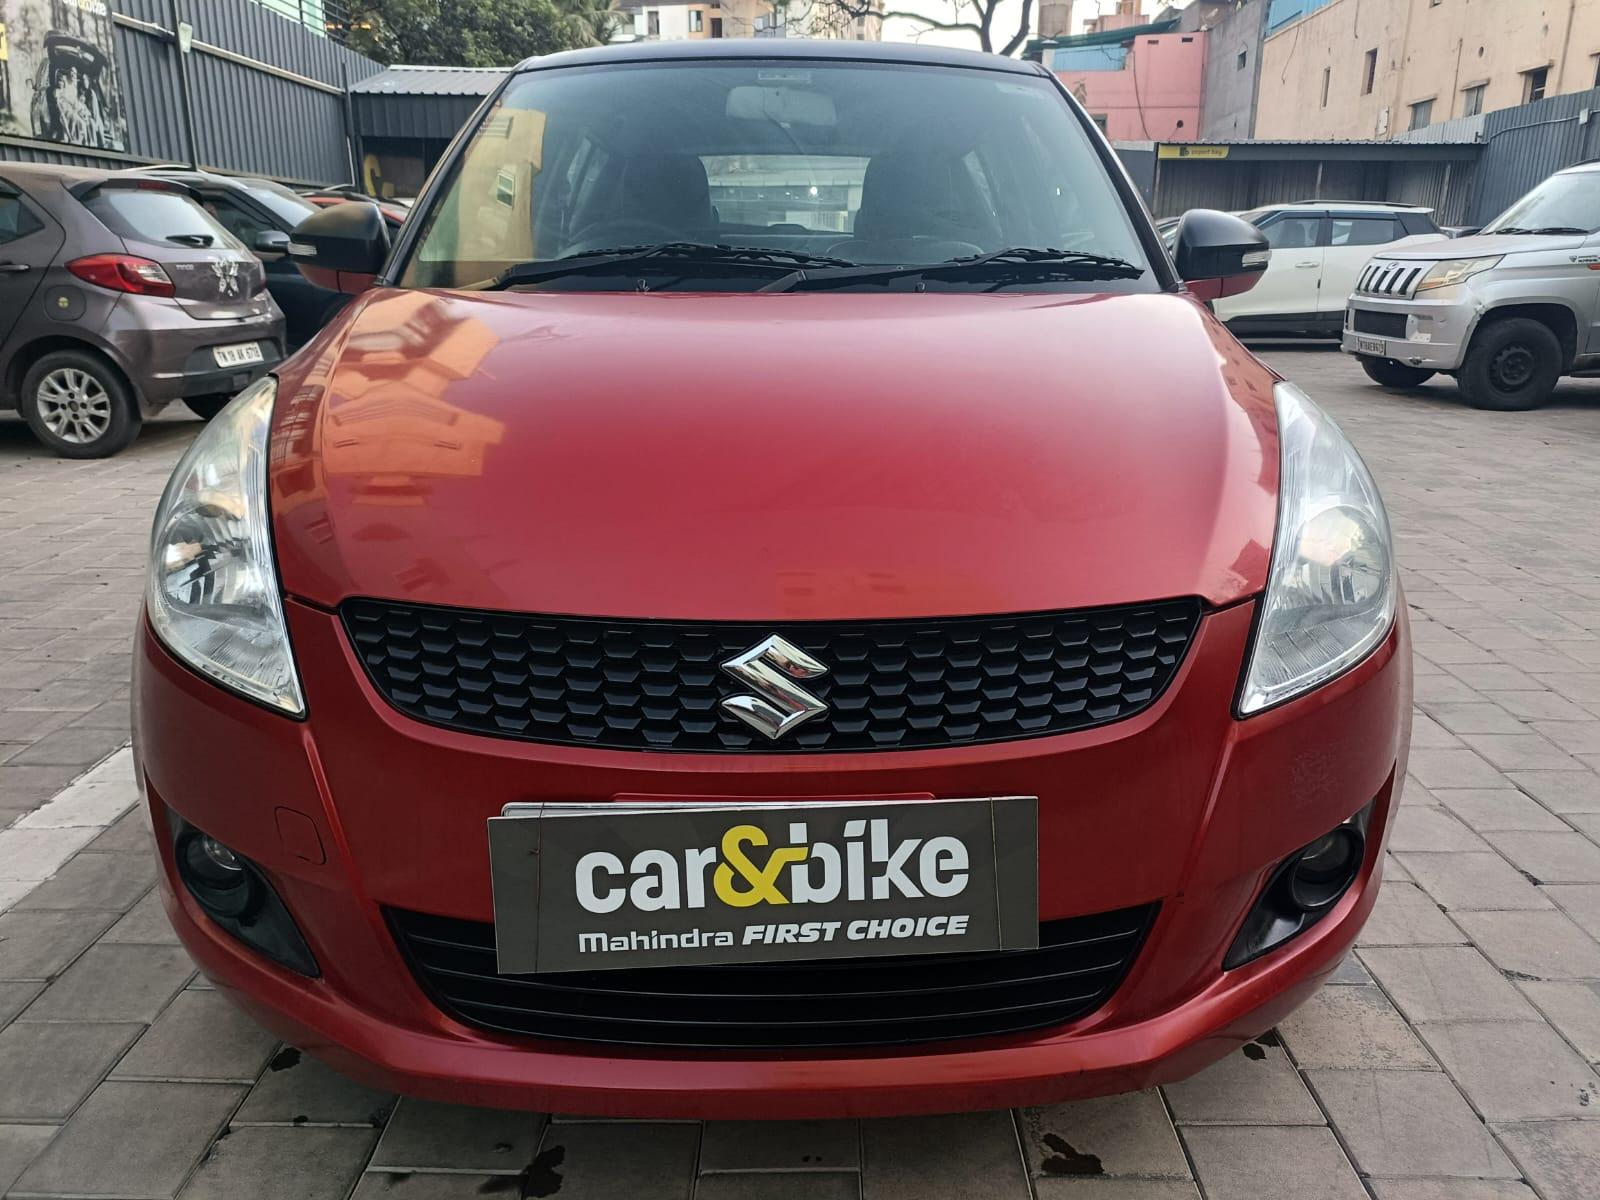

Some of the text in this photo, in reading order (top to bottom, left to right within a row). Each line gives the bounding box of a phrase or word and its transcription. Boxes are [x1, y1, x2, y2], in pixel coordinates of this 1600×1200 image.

[575, 818, 970, 914] car&bike
[578, 914, 970, 953] Mahindra FIRST CHOICE
